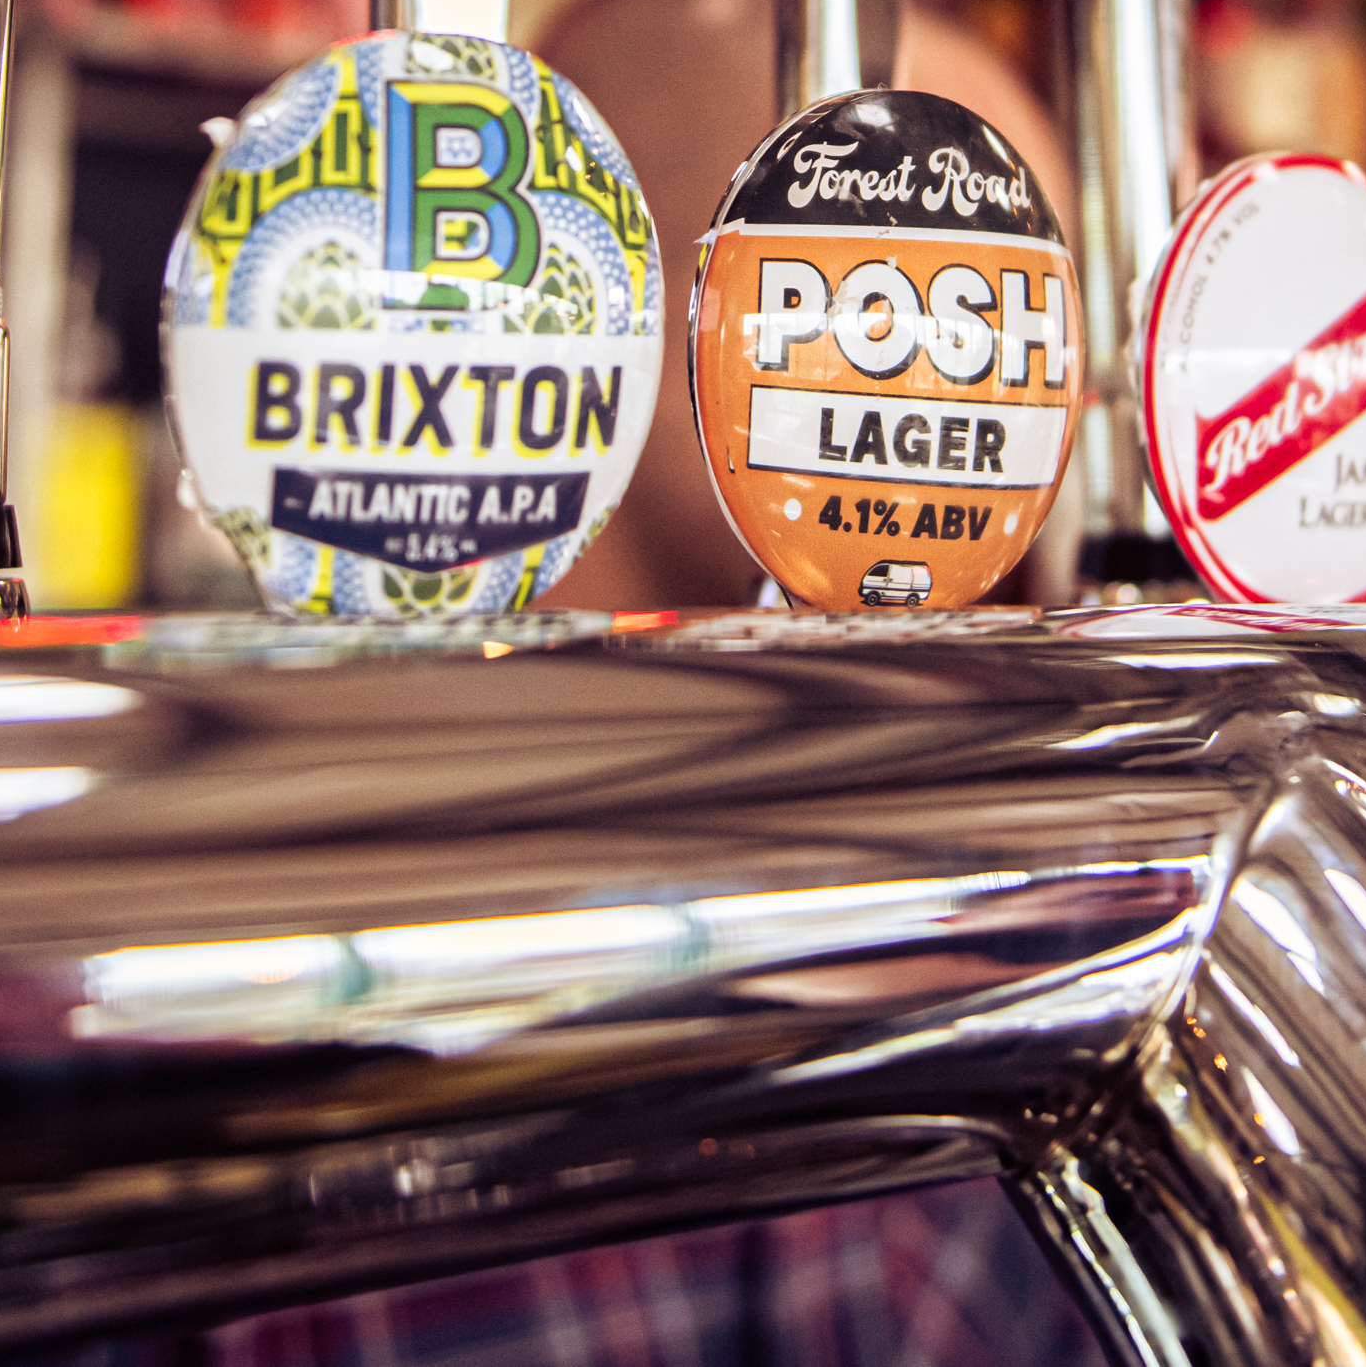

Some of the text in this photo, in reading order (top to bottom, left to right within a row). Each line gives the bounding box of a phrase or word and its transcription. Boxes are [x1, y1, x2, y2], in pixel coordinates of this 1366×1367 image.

[382, 79, 543, 310] B
[787, 141, 1032, 217] Forest Road
[755, 257, 1067, 390] POSH
[246, 360, 624, 458] BRIXTON
[818, 406, 1007, 474] LAGER
[1203, 381, 1303, 494] Red
[307, 479, 472, 525] ATLANTIC
[818, 495, 993, 542] 4.1% ABV
